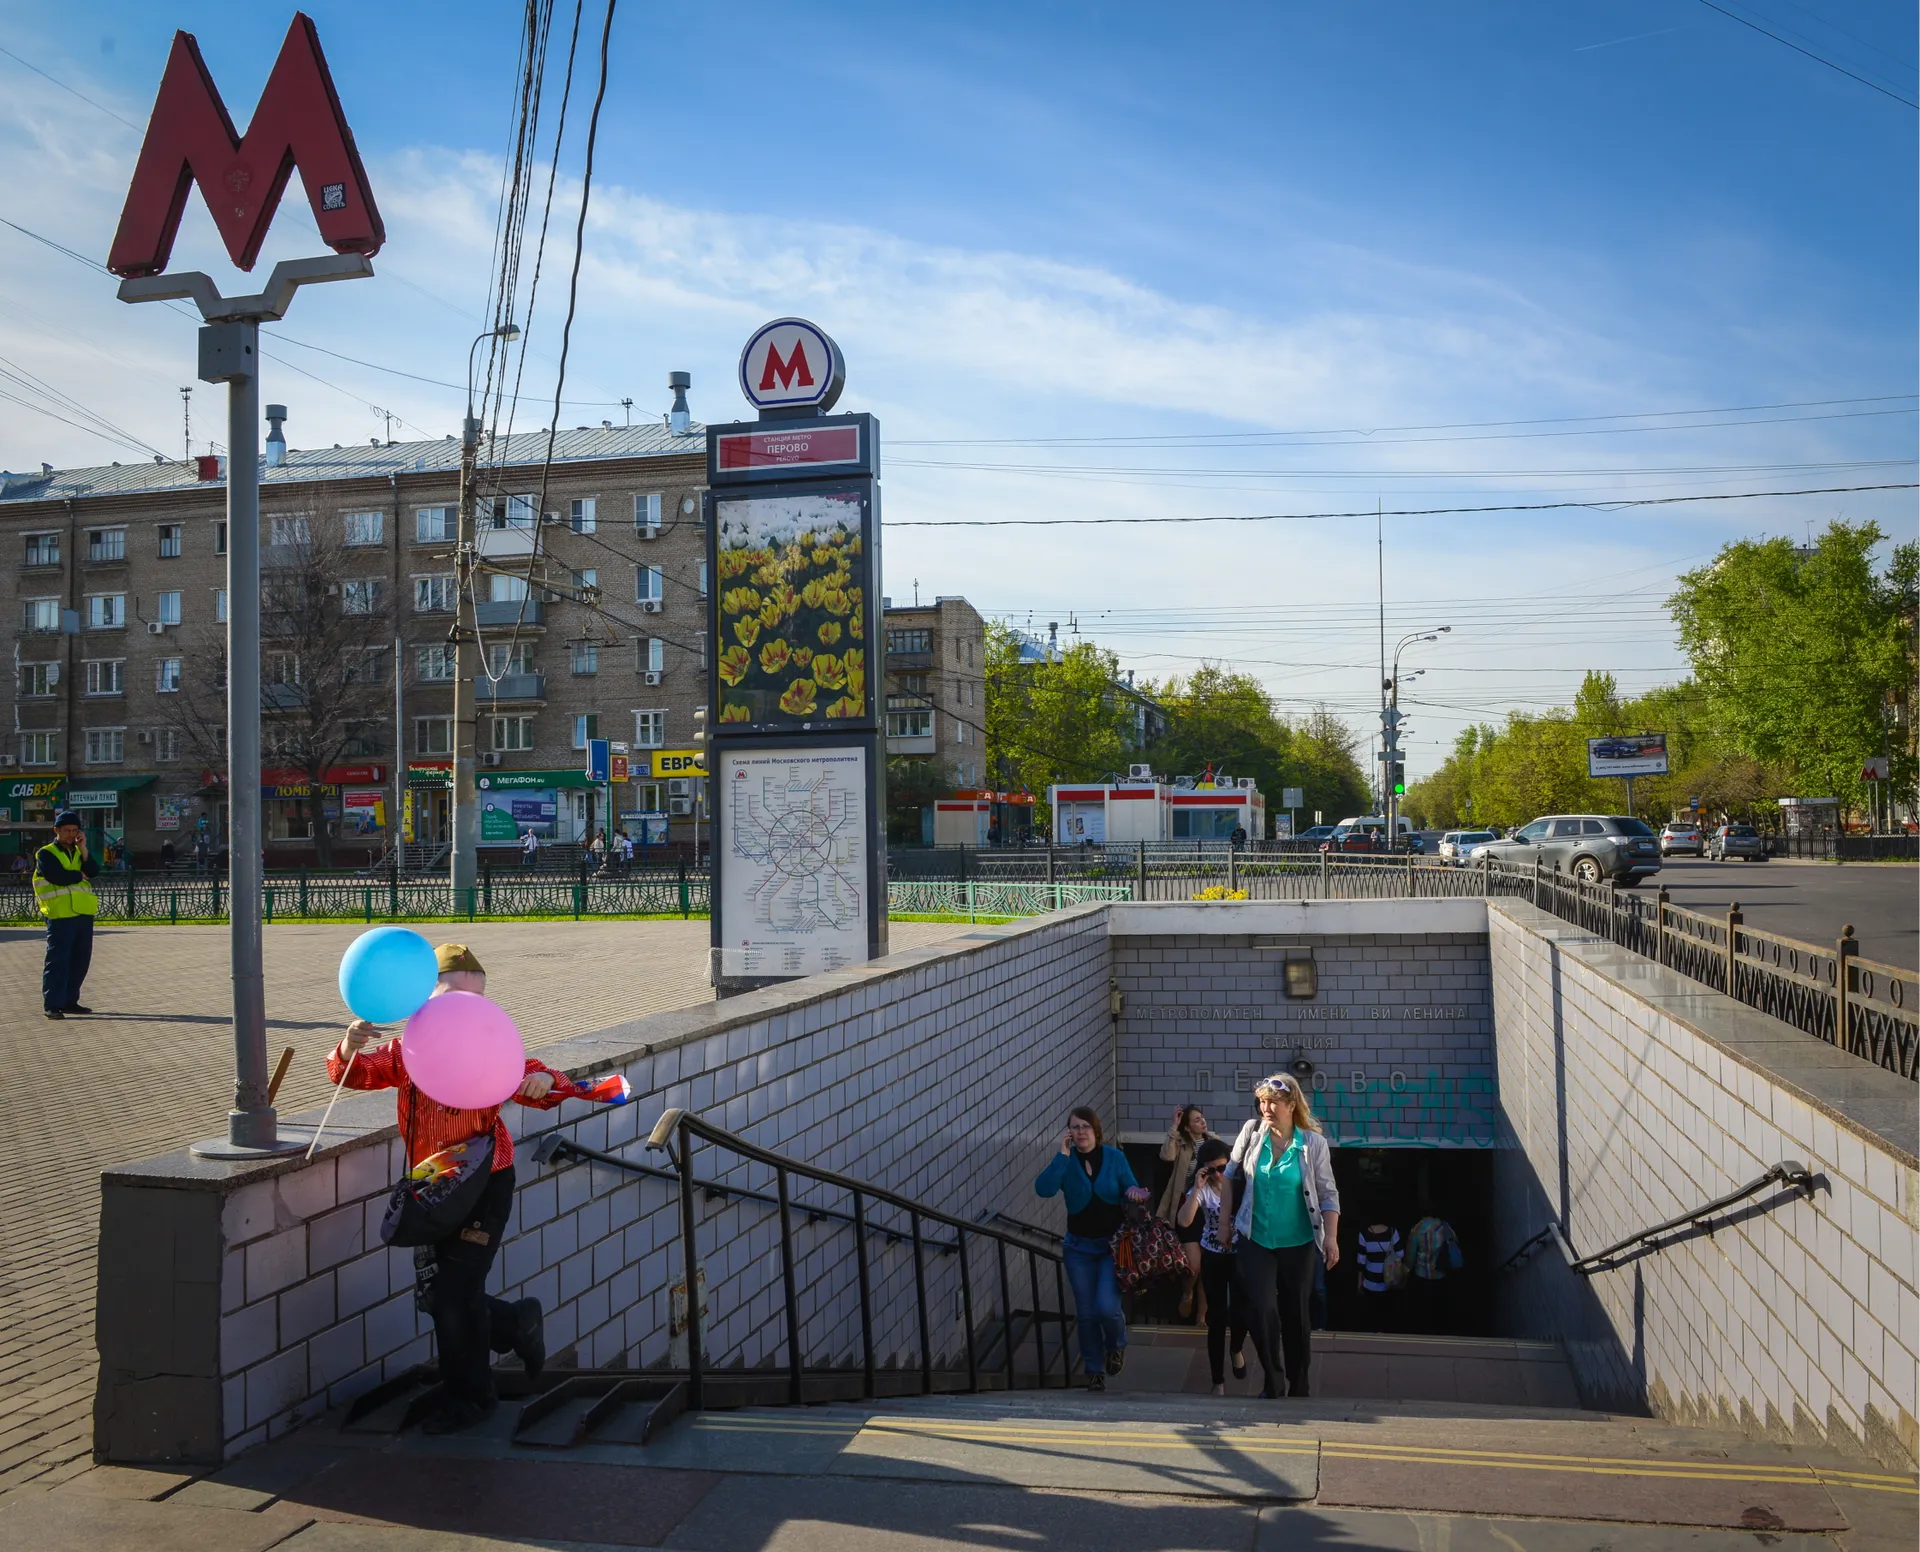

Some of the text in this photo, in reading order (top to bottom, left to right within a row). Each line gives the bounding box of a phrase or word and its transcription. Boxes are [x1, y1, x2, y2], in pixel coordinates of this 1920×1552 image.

[107, 10, 386, 278] М
[759, 338, 814, 391] М
[767, 442, 809, 454] ПЕРОВО
[732, 756, 858, 766] Схема линий Московского метрополитена
[70, 792, 116, 802] АПТЕЧНЫЙ ПУНКТ
[274, 785, 338, 797] ЛОМБРД
[1136, 1007, 1264, 1020] МЕТРОПОЛИТЕН
[1297, 1007, 1350, 1020] ИМЕНИ
[1402, 1007, 1466, 1020] ЛЕНИНА
[1262, 1037, 1334, 1050] СТАНЦИЯ
[1196, 1069, 1408, 1093] ПЕОВО
